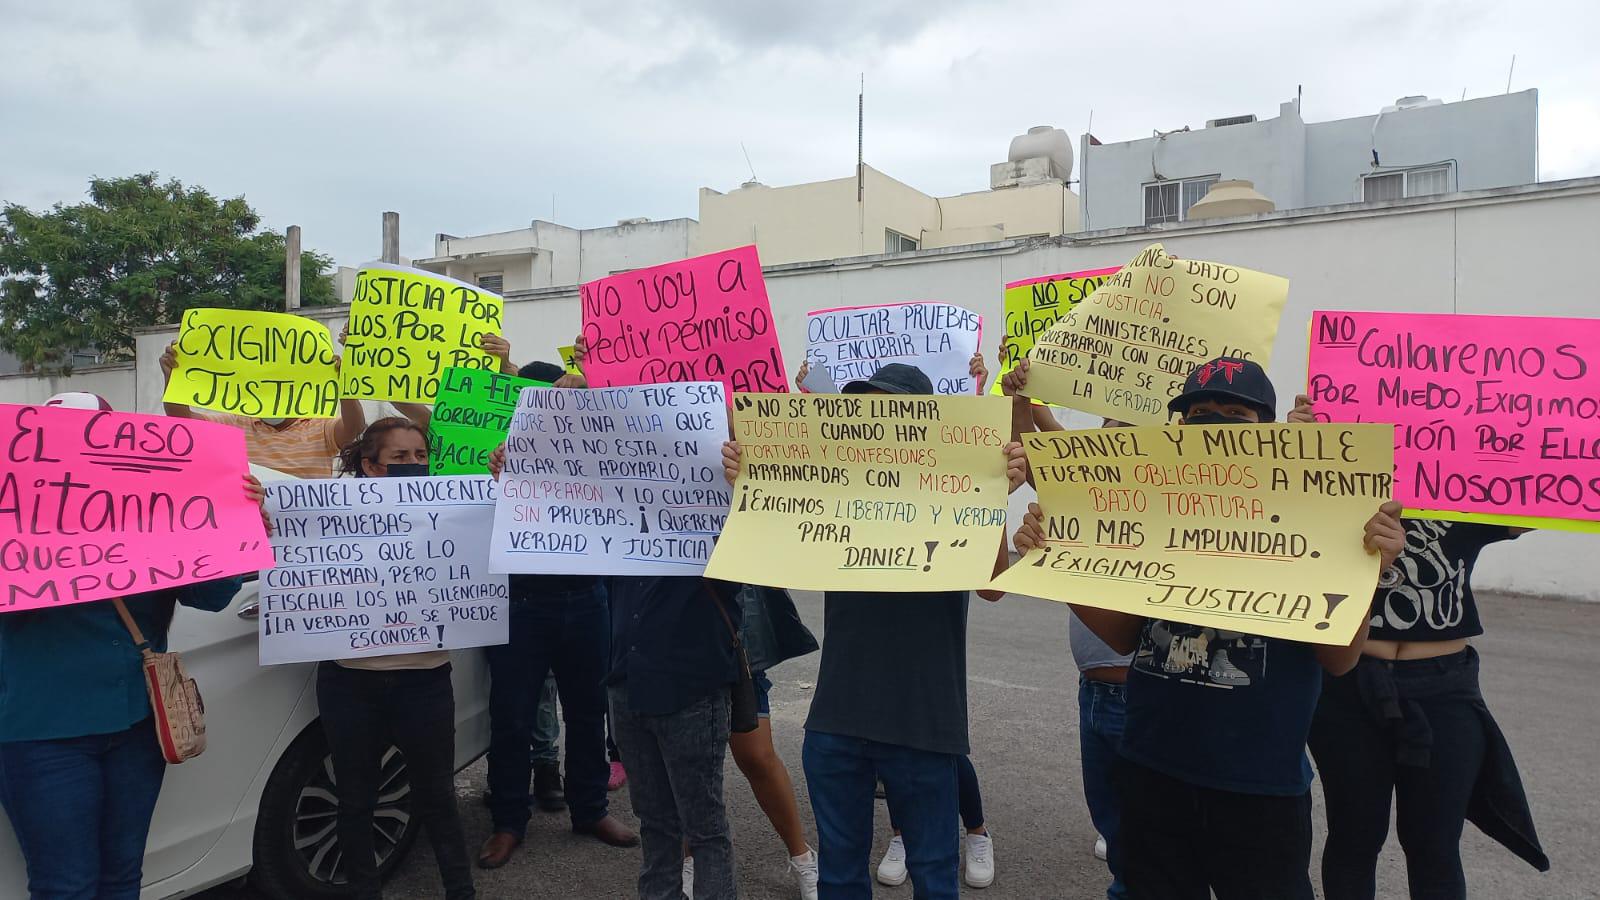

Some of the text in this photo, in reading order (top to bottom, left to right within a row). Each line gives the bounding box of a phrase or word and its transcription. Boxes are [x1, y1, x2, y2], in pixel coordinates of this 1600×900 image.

[1187, 260, 1239, 283] BAJO
[353, 271, 502, 330] JUSTICIA POR
[1032, 282, 1058, 307] NO
[1146, 274, 1175, 296] NO
[1191, 283, 1237, 310] SON
[1094, 292, 1170, 323] JUSTICIA.
[347, 310, 483, 349] LLOS, POR LO
[583, 306, 767, 365] Pedir Permiso
[808, 304, 980, 343] OCULTAR PRUEBAS
[1086, 315, 1208, 357] MINISTERIALES
[1320, 315, 1356, 342] NO
[179, 311, 336, 365] EXIGIMOS
[806, 333, 951, 364] ES ENCUBRIR LA
[1041, 329, 1113, 356] QUEBRARON
[1122, 346, 1148, 364] CON
[345, 342, 411, 369] TUYOS
[449, 349, 494, 371] POR
[1036, 348, 1081, 369] MIEDO.
[1136, 372, 1154, 390] SE
[186, 367, 339, 417] JUSTICIA
[343, 373, 440, 399] LOS MIO
[445, 368, 472, 394] LA
[484, 374, 521, 404] FIS
[527, 389, 565, 411] UNICO
[640, 388, 678, 407] FUE
[685, 385, 723, 405] SER
[937, 378, 968, 394] QUE
[1073, 380, 1092, 399] LA
[1310, 374, 1359, 404] POR
[510, 411, 714, 434] ADRE DE UNA HIJA QUE
[789, 399, 805, 418] SE
[813, 399, 863, 418] PUEDE
[871, 400, 941, 421] LLAMAR
[9, 407, 194, 463] EL CASO
[742, 420, 808, 438] JUSTICIA
[820, 422, 884, 441] CUANDO
[896, 425, 927, 442] HAY
[1476, 424, 1525, 452] POR
[507, 438, 537, 454] HOY
[550, 438, 574, 454] YA
[584, 438, 607, 455] NO
[674, 441, 698, 457] EN
[740, 444, 937, 468] TORTURA Y CONFESIONES
[1163, 430, 1184, 456] Y
[1203, 429, 1358, 462] MICHELLE
[504, 459, 713, 485] LUGAR DE APOYARLO, LO
[748, 464, 981, 493] ARRANCADAS CON MIEDO.
[1036, 465, 1121, 482] FUERON
[1134, 463, 1258, 488] OBLIGADOS
[1271, 467, 1289, 491] A
[1303, 469, 1392, 499] MENTIR
[0, 473, 218, 535] Aitanna
[360, 482, 383, 505] ES
[398, 480, 497, 501] INOCENTE
[503, 479, 730, 506] GOLPEARON Y LO CULPAN
[1089, 486, 1280, 523] BAJO TORTURA.
[320, 512, 412, 536] PRUEBAS
[428, 512, 439, 531] Y
[513, 504, 539, 522] SIN
[548, 508, 633, 526] PRUEBAS.
[835, 500, 917, 523] LIBERTAD
[930, 504, 942, 525] Y
[953, 506, 1007, 527] VERDAD
[509, 532, 718, 559] VERDAD Y JUSTICIA
[798, 521, 851, 543] PARA
[1048, 515, 1320, 559] NO MAS IMPUNIDAD.
[0, 539, 128, 573] QUEDE
[272, 539, 455, 564] TESTIGOS QUE LO
[0, 555, 224, 606] MPUNE
[267, 565, 471, 588] CONFIRMAN, PERO LA
[264, 584, 509, 611] FISCALIA LOS HA SILENCIADO.
[303, 615, 370, 631] VERDAD
[385, 610, 408, 625] NO
[421, 609, 439, 622] SE
[448, 606, 498, 622] PUEDE
